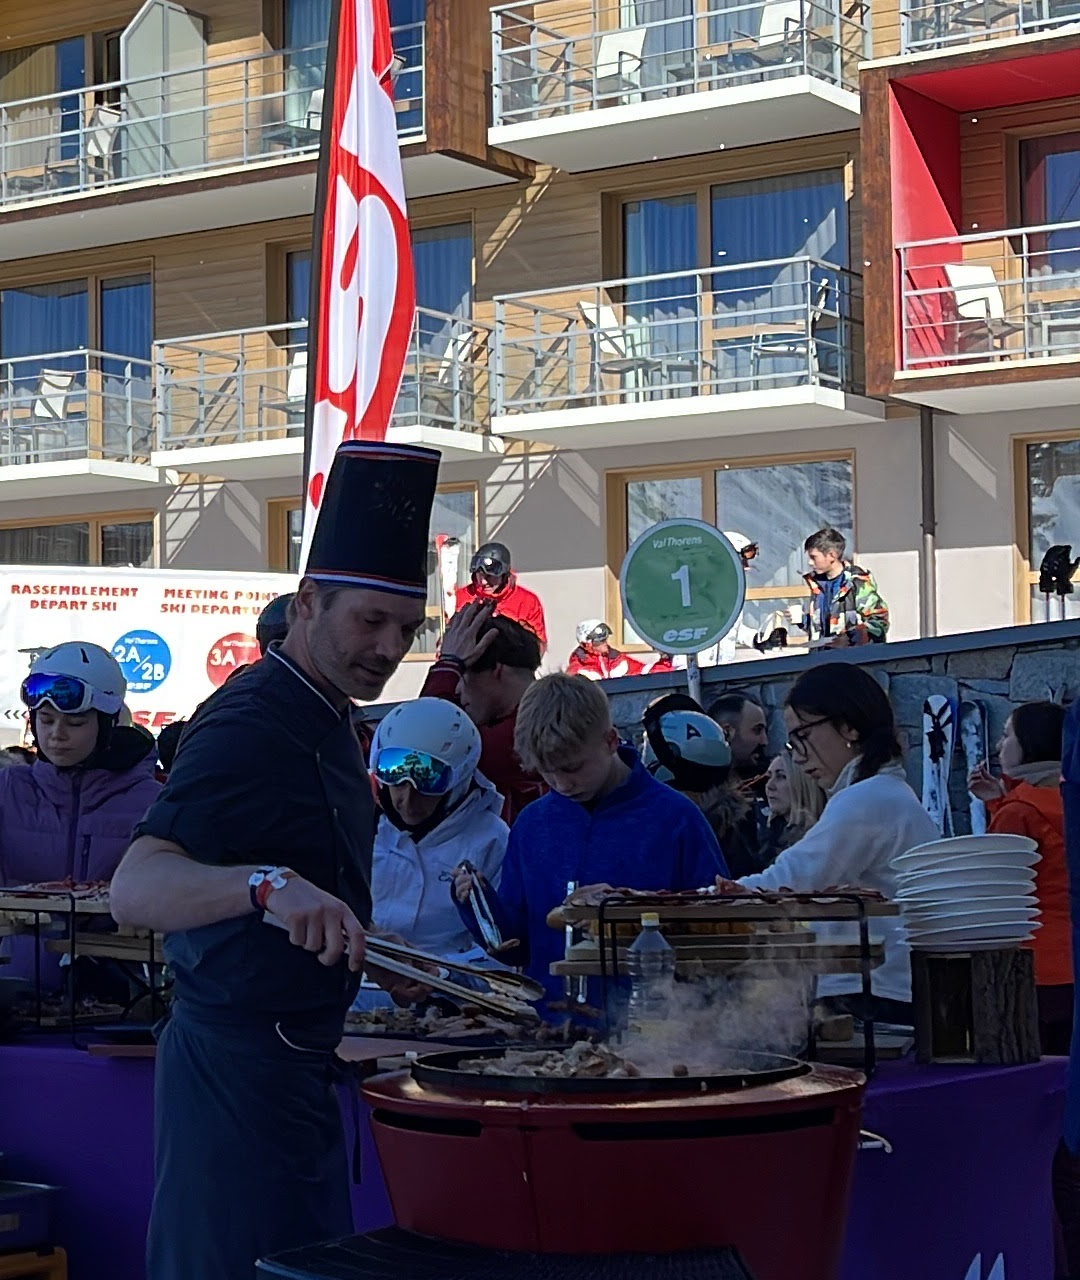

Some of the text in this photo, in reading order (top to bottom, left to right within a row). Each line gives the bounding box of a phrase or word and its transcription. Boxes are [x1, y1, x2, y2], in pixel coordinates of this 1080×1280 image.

[11, 584, 138, 597] RASSEMBLEMENT
[671, 564, 691, 607] 1
[164, 588, 279, 601] MEETING POINT
[92, 601, 117, 611] SKI
[160, 603, 261, 615] SKI DEPARTU
[210, 648, 236, 666] 3A
